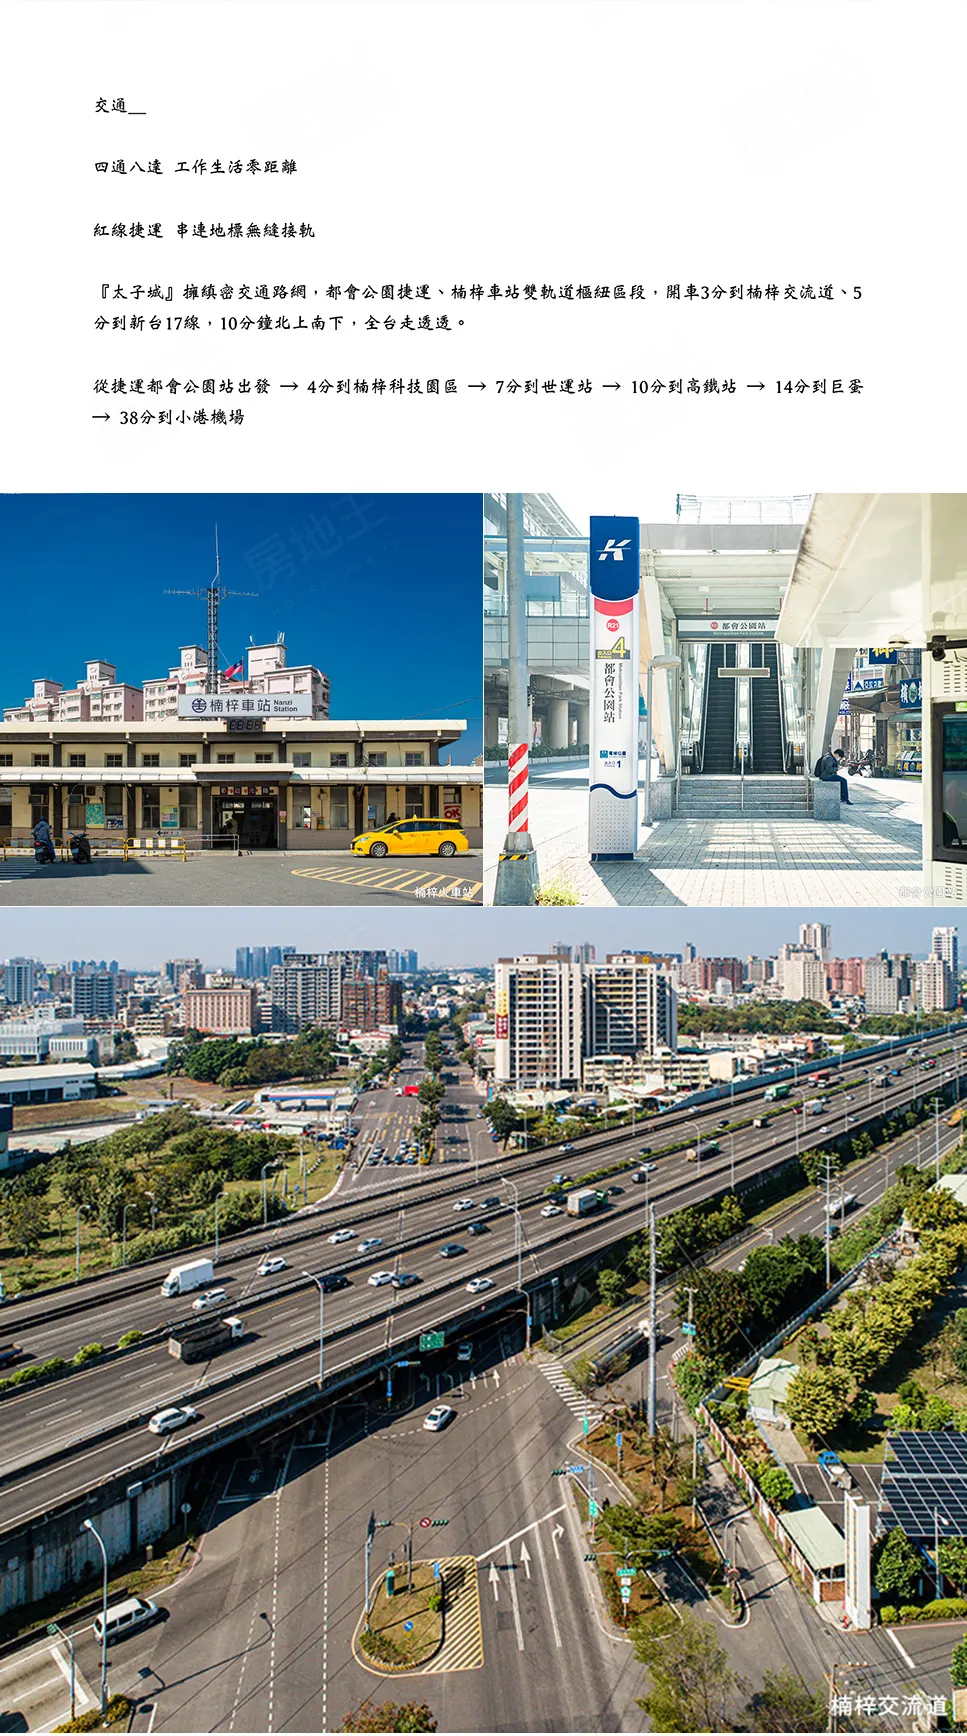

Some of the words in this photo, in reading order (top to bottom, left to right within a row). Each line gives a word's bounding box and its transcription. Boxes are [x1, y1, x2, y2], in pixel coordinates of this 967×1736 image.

[722, 621, 766, 630] 都會公園站
[612, 636, 627, 659] 4
[604, 662, 616, 723] 都會公園站
[209, 698, 271, 713] 楠梓車站
[273, 705, 298, 713] Station
[444, 807, 461, 819] OK
